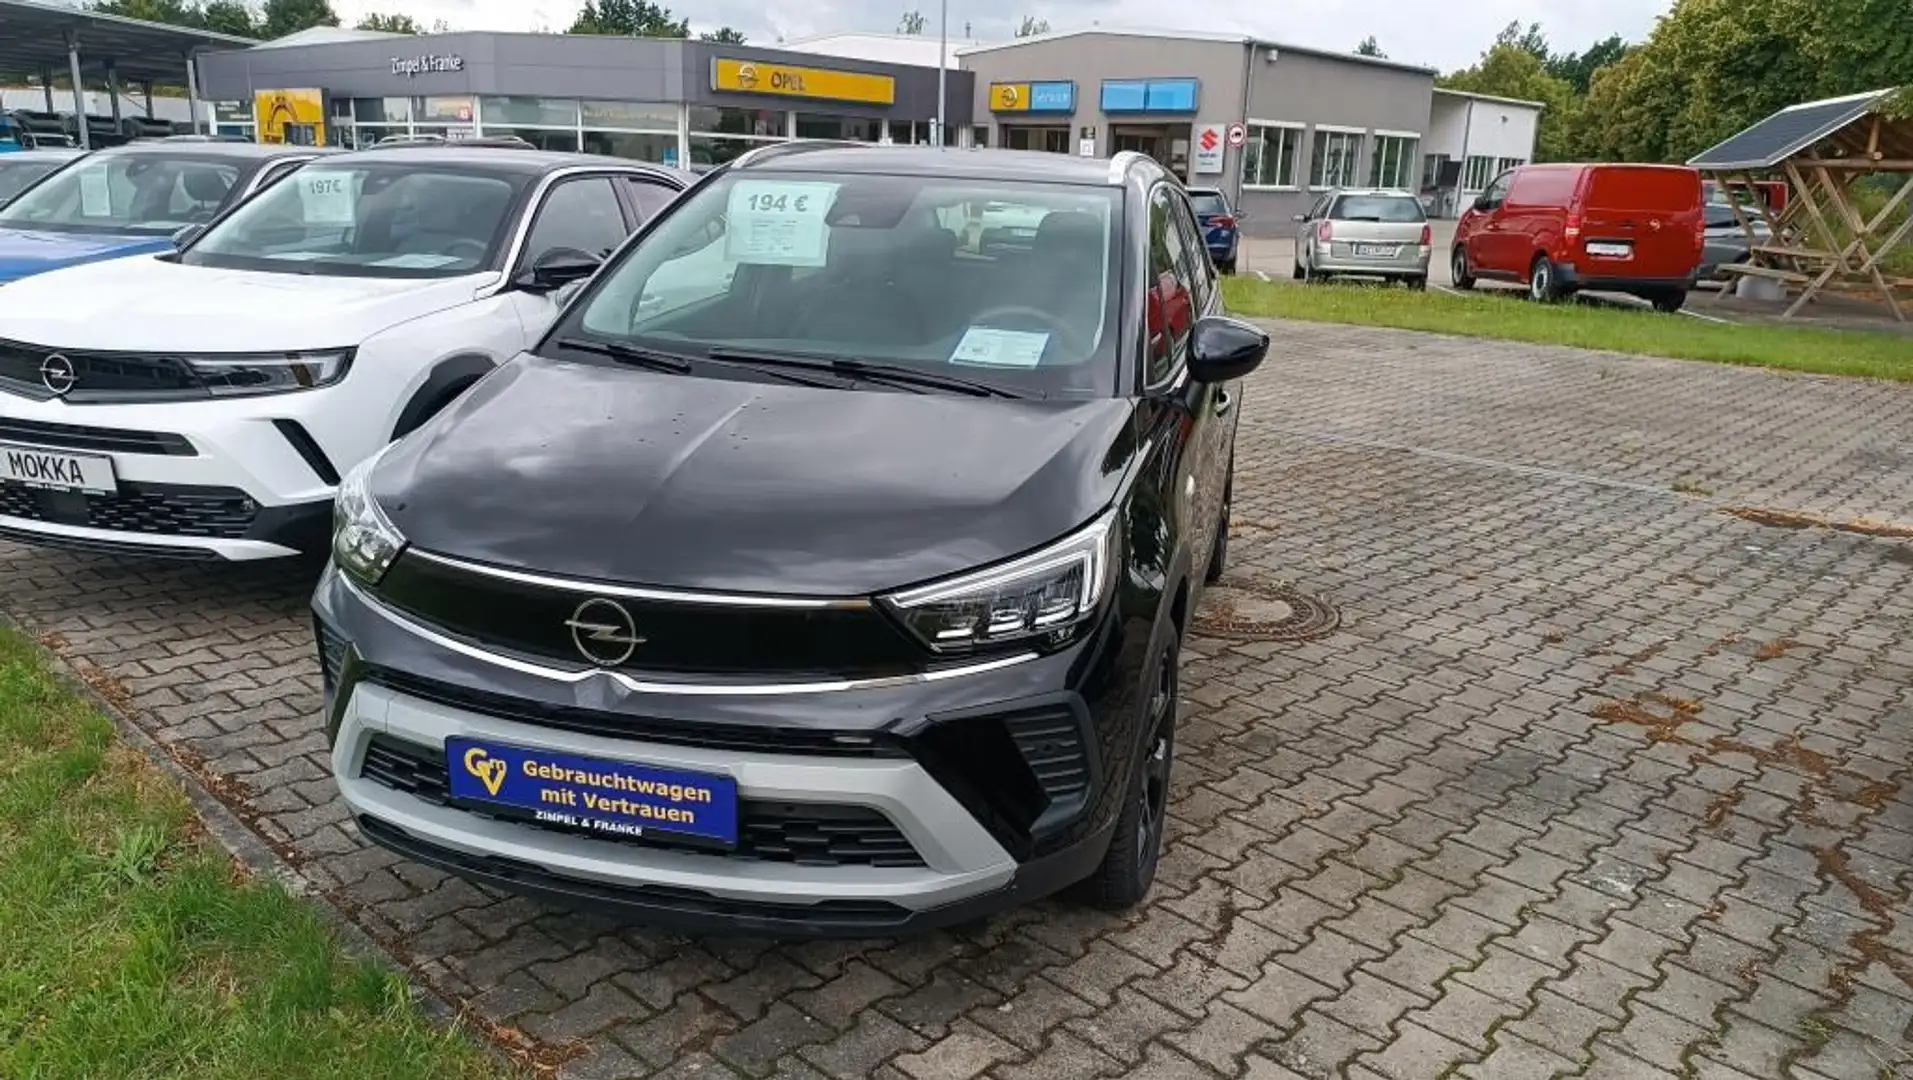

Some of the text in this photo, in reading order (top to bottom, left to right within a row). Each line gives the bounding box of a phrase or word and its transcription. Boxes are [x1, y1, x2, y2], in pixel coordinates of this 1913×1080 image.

[770, 71, 806, 91] OPEL
[748, 194, 809, 212] 194 €
[7, 451, 85, 484] MOKKA
[523, 760, 712, 804] Gebrauchtwagen
[541, 787, 695, 825] mit Vertrauen
[581, 818, 591, 828] &
[594, 819, 643, 836] FRANKE
